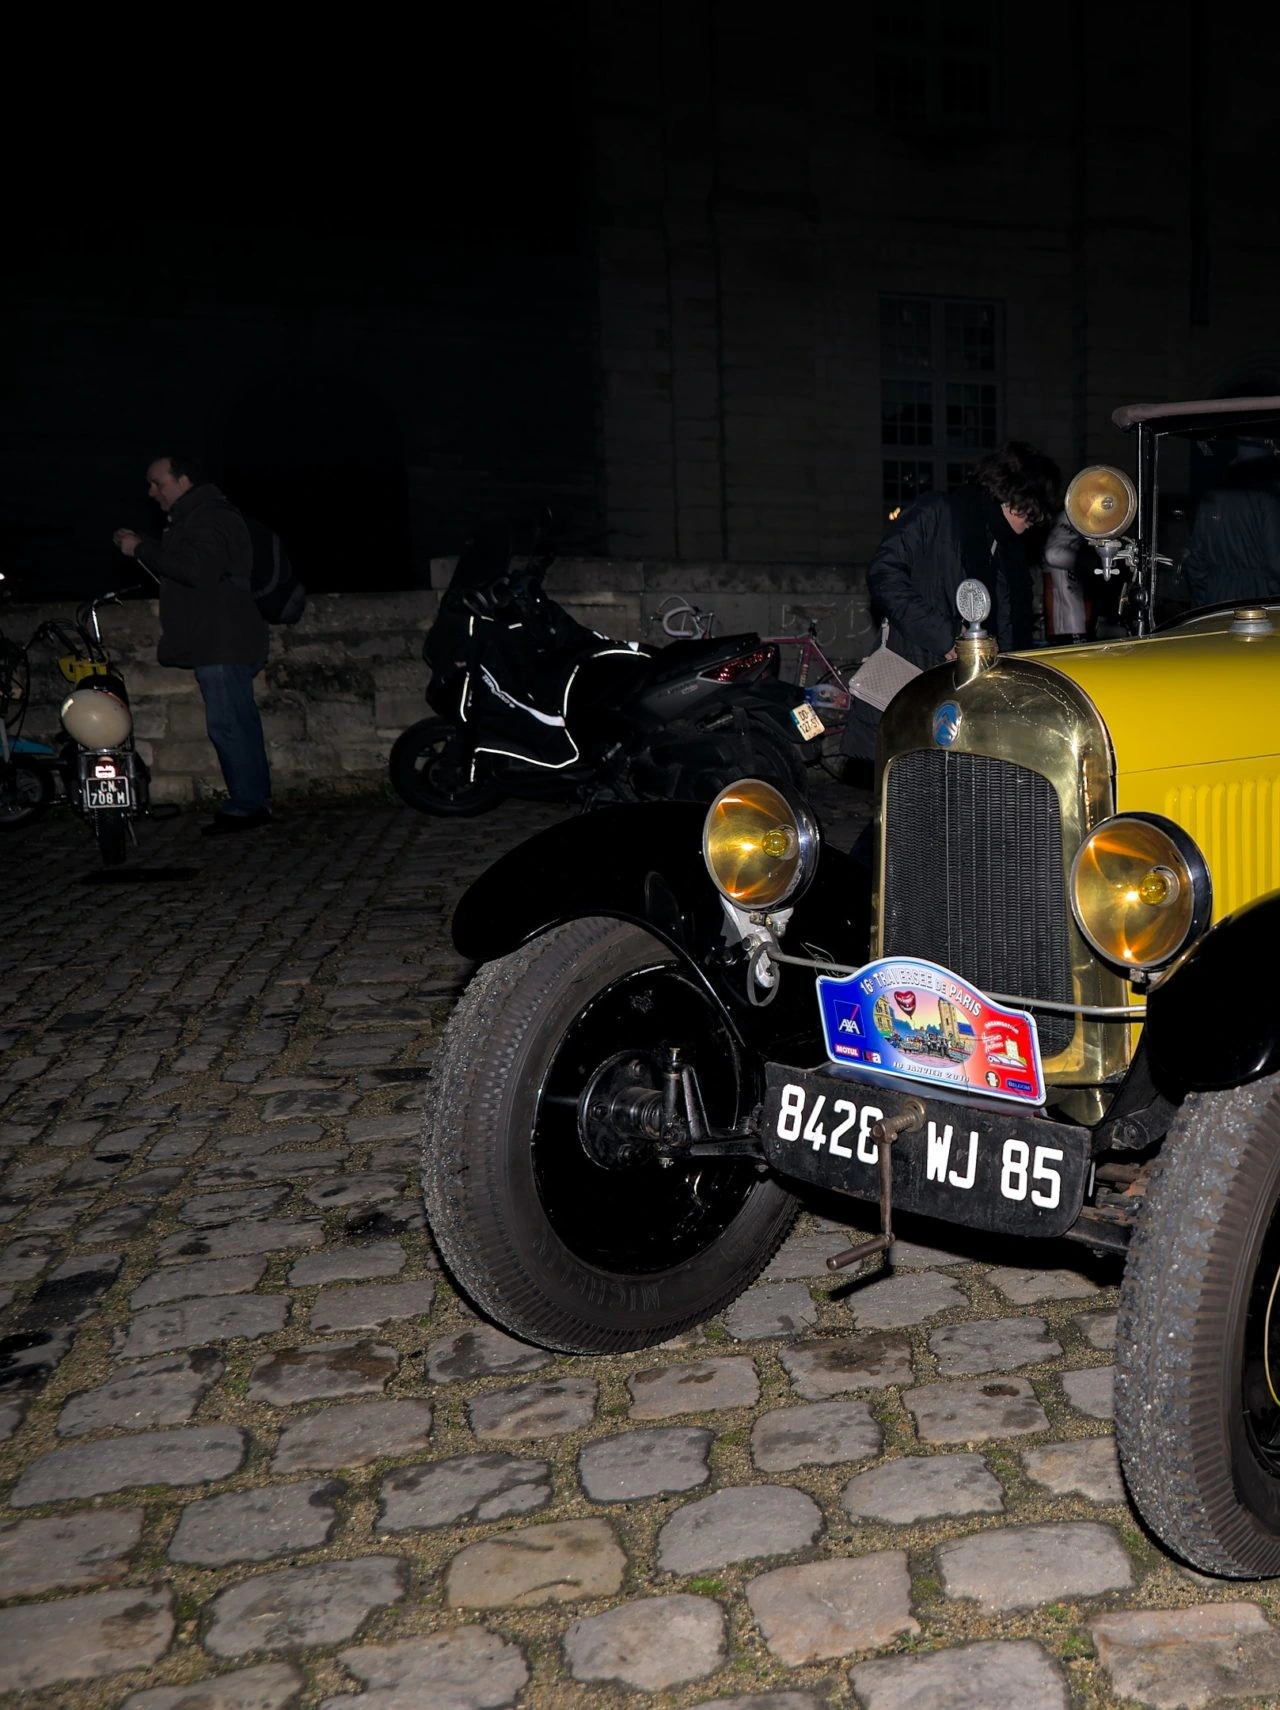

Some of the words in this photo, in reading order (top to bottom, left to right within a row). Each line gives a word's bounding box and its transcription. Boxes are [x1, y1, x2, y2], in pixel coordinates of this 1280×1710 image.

[91, 792, 113, 805] 708
[949, 983, 982, 1017] PARIS
[838, 1018, 861, 1035] AXA
[835, 1044, 859, 1056] MOTUL
[906, 1063, 944, 1078] JANVIER
[777, 1083, 885, 1166] 8428
[926, 1120, 979, 1190] WJ
[1001, 1138, 1064, 1209] 85
